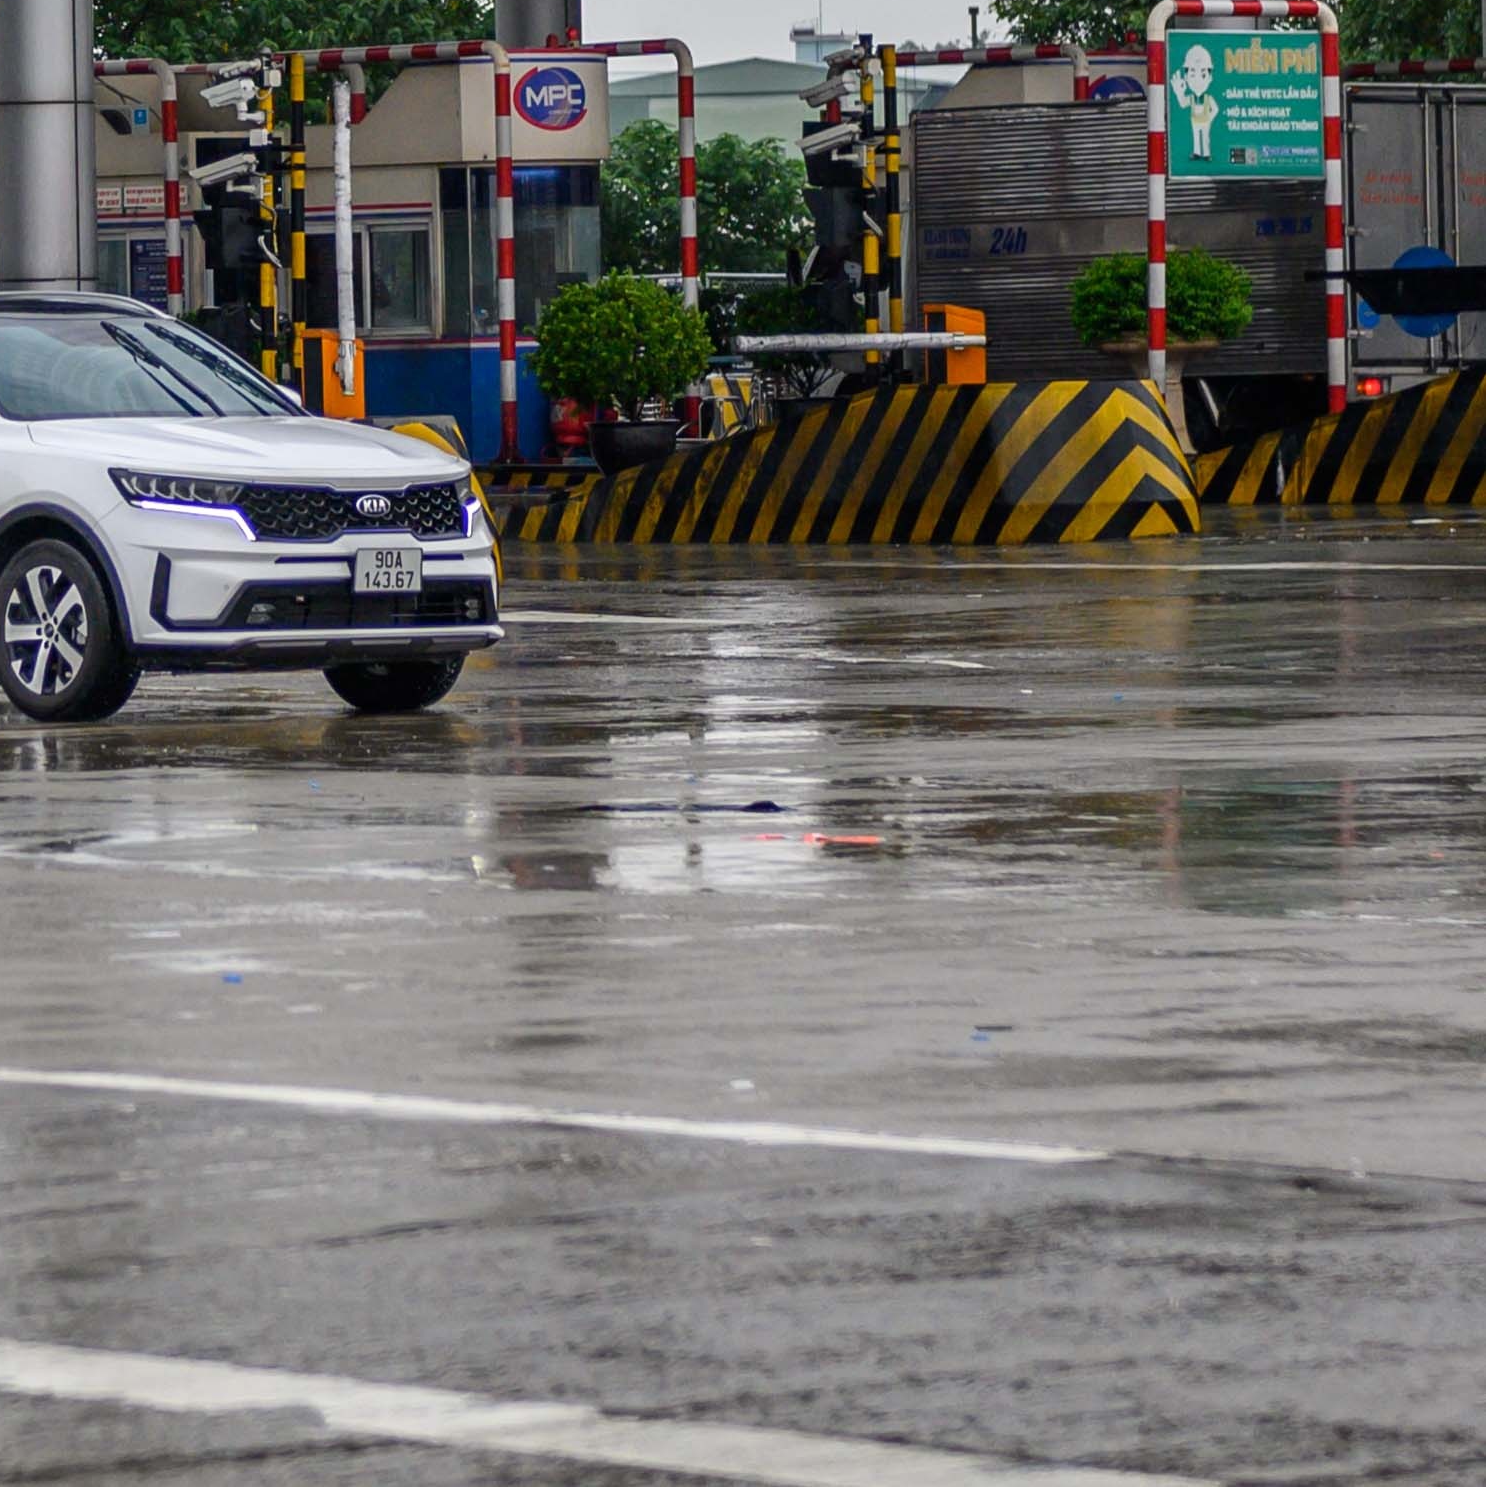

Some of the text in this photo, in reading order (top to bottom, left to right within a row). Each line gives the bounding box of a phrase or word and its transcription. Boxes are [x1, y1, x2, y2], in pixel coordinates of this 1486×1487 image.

[1224, 37, 1317, 74] MIỄN PHÍ
[525, 84, 582, 108] MPC
[990, 226, 1027, 254] 24h
[362, 499, 387, 513] KIA
[375, 551, 403, 569] 90A
[364, 571, 415, 589] 143.67
